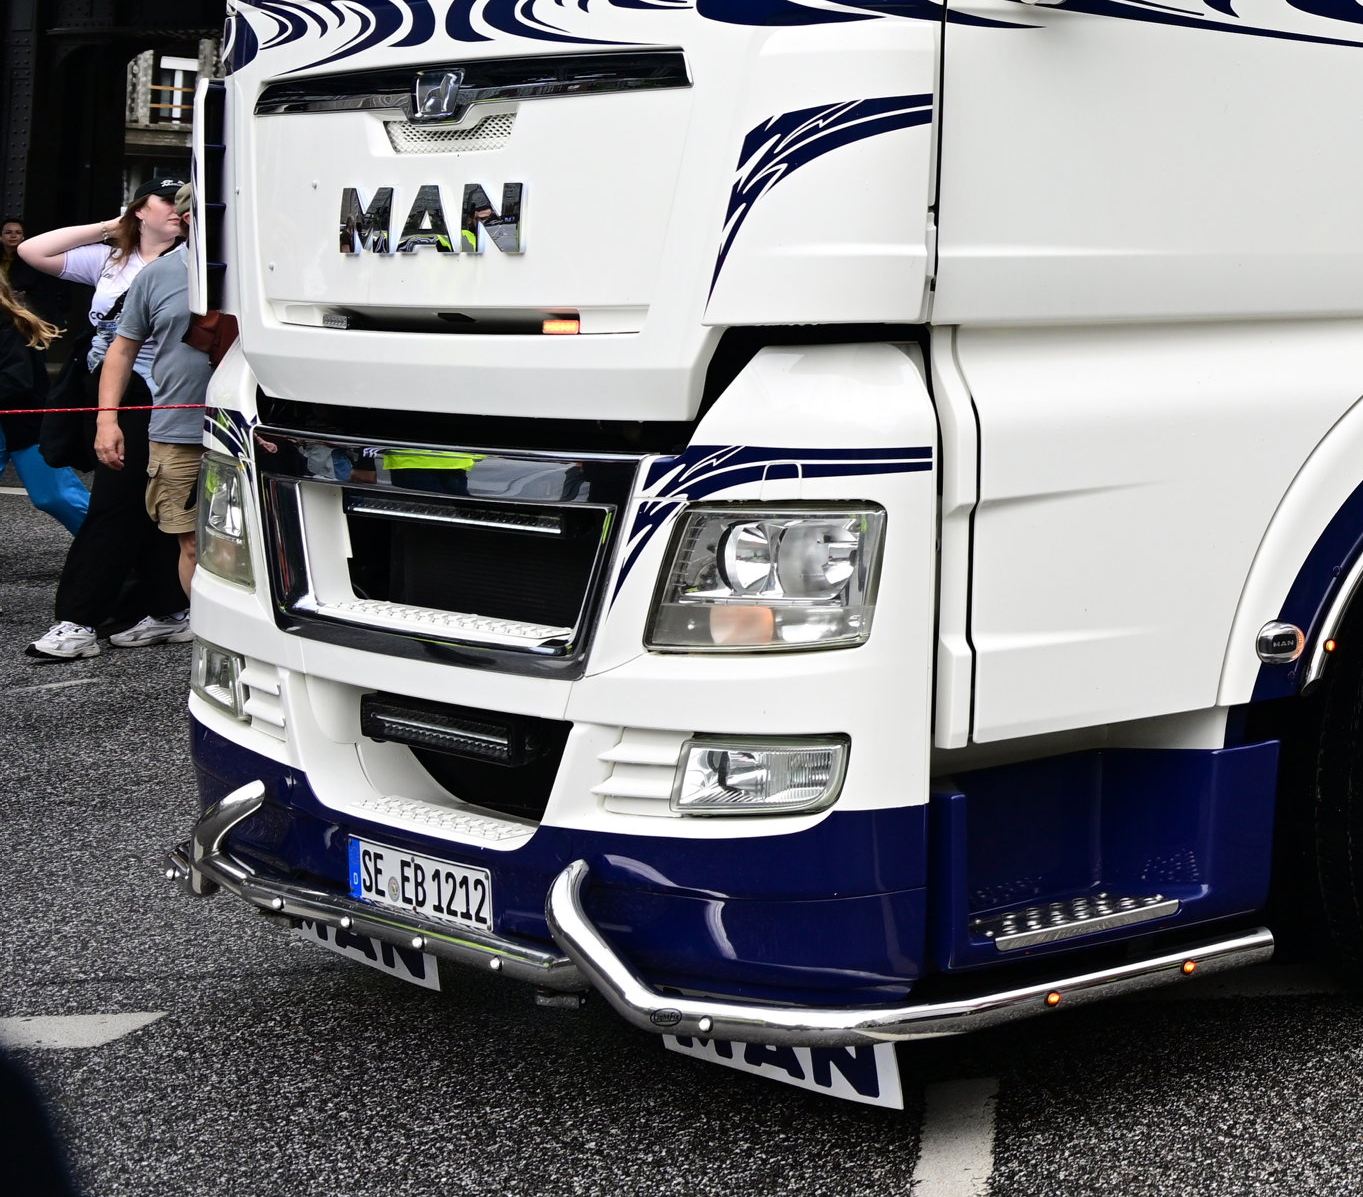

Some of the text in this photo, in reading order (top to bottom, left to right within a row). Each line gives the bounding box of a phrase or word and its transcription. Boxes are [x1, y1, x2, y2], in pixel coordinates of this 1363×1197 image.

[340, 182, 526, 254] MAN
[362, 850, 488, 924] SE EB 1212
